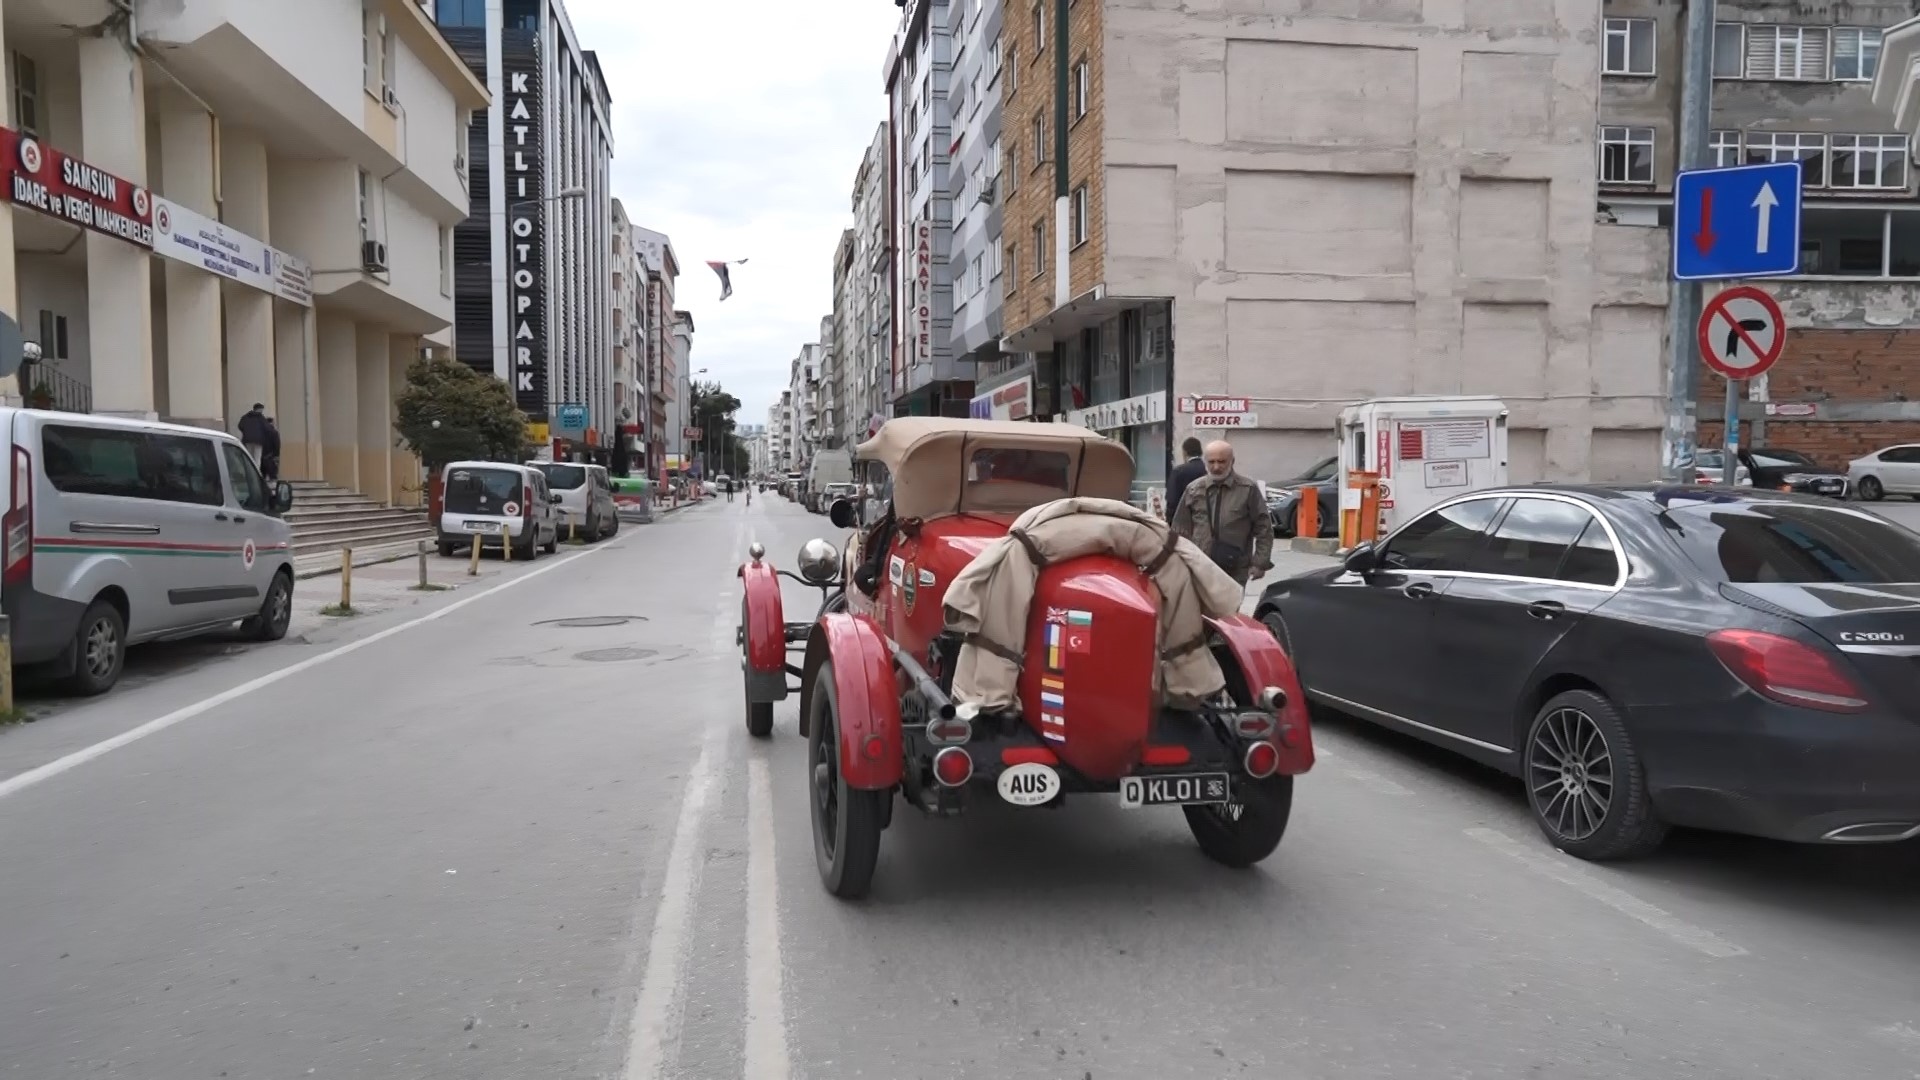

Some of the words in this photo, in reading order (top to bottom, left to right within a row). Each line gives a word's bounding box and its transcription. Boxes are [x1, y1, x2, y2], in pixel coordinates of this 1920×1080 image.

[510, 72, 531, 198] KATLI
[14, 170, 48, 210] İDARE
[48, 194, 62, 214] ve
[62, 193, 94, 225] VERGİ
[63, 158, 116, 202] SAMSUN
[512, 217, 534, 391] OTOPARK
[919, 306, 929, 358] OTEL
[1194, 415, 1241, 425] BERBER
[1197, 399, 1246, 412] OTOPARK
[1010, 773, 1048, 795] AUS
[1125, 782, 1139, 804] Q
